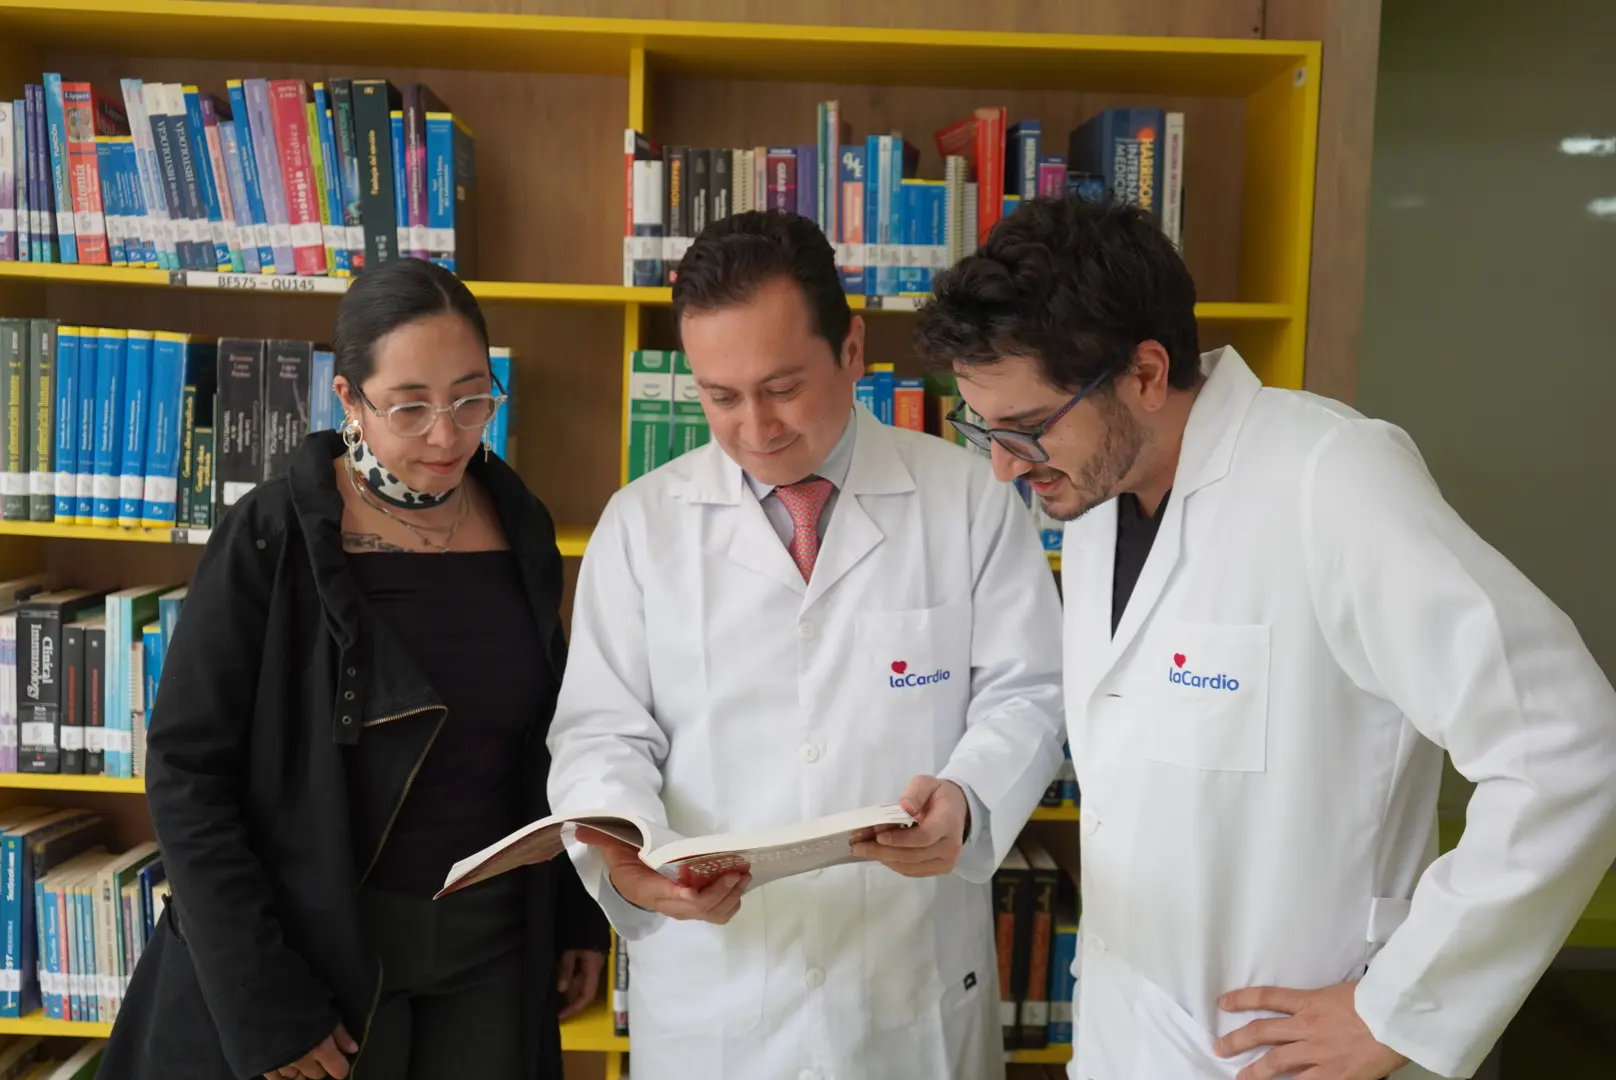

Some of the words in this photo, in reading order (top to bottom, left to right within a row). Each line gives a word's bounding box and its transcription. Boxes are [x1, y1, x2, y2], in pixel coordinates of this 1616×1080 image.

[293, 170, 309, 222] siología
[1126, 143, 1139, 204] INTERNA
[217, 275, 257, 290] BF575
[271, 277, 316, 291] QU145
[27, 623, 42, 700] Immunology
[42, 636, 53, 684] Clinical
[889, 669, 951, 688] laCardio
[1169, 667, 1240, 692] laCardio
